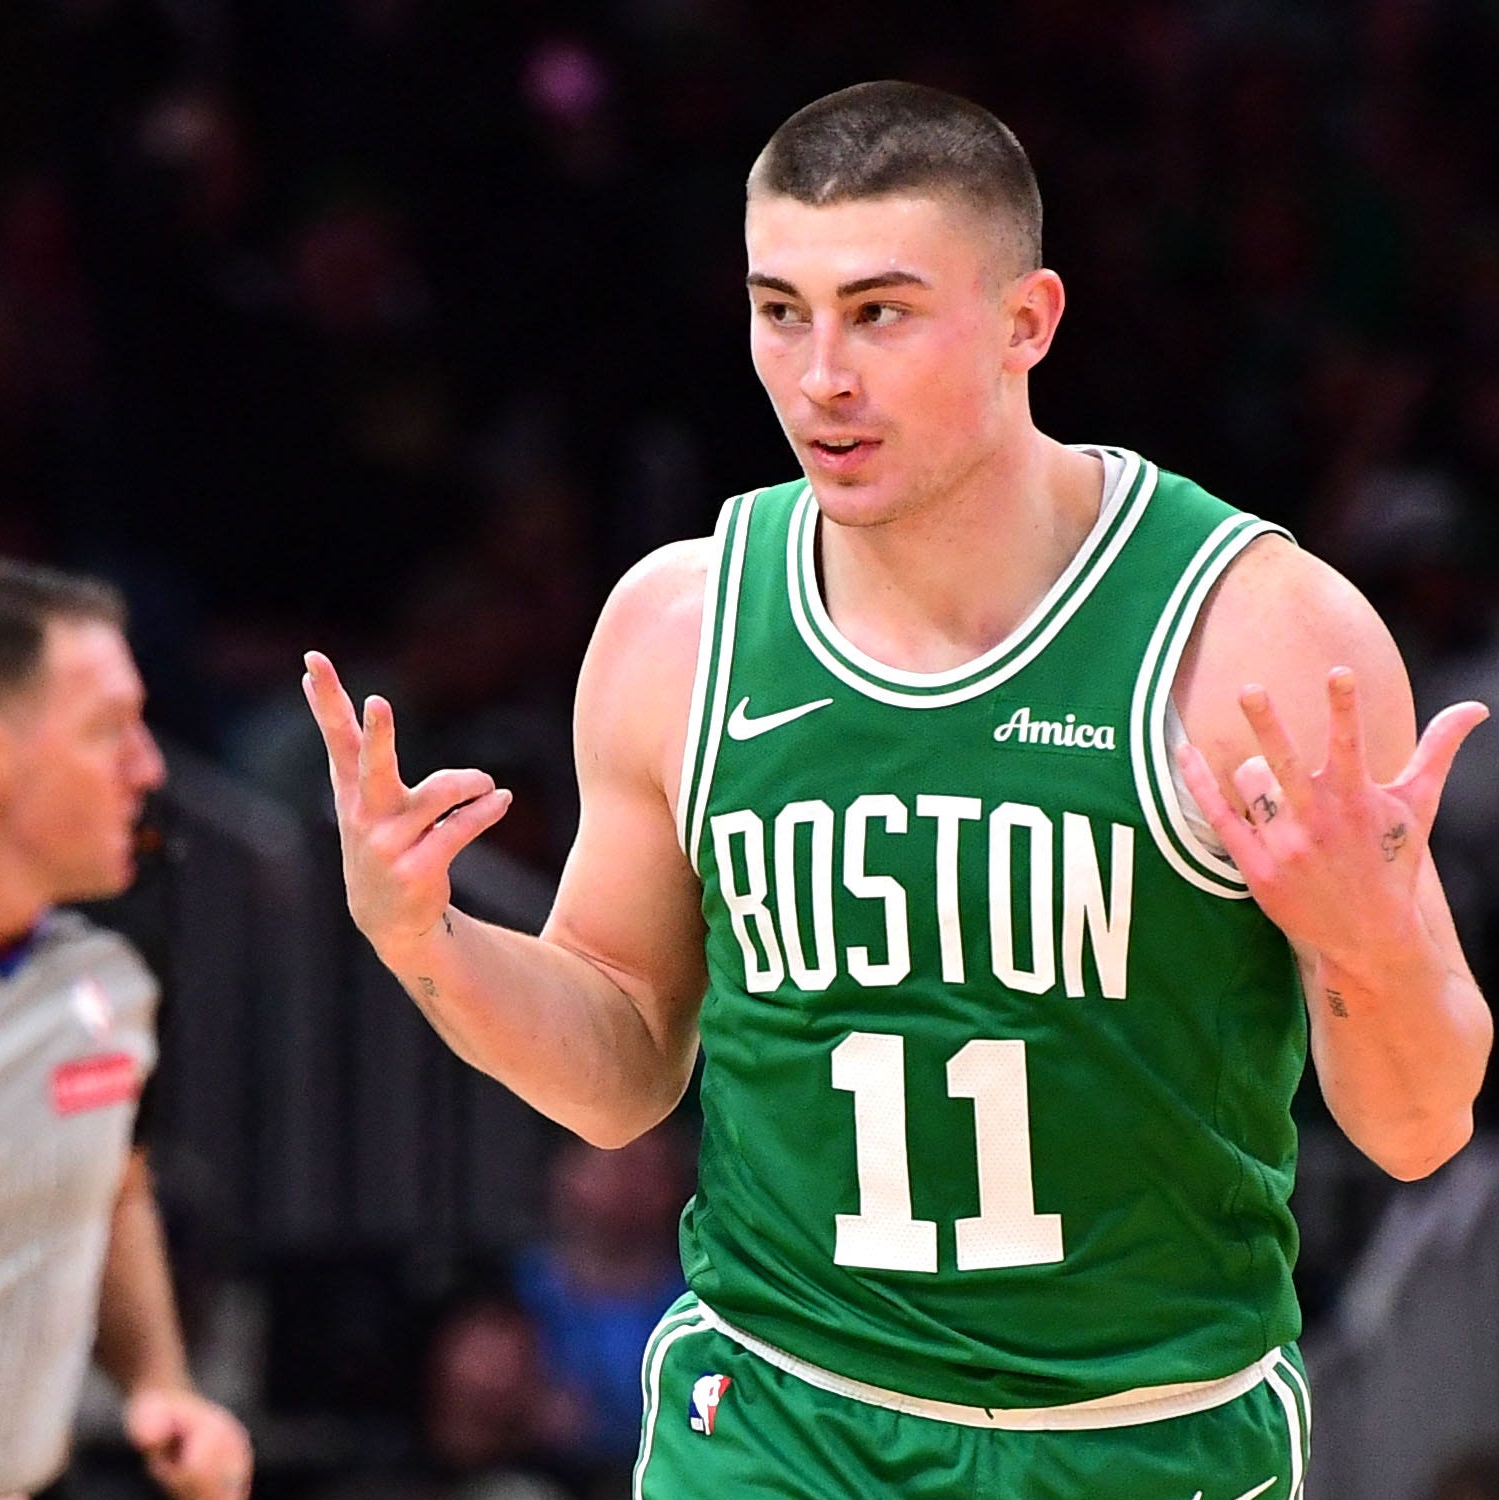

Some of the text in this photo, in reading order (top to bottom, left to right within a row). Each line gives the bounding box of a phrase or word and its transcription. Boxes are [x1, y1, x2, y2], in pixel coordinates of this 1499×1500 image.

[993, 706, 1117, 750] Amica
[710, 793, 1135, 1000] BOSTON
[830, 1031, 1065, 1274] 11
